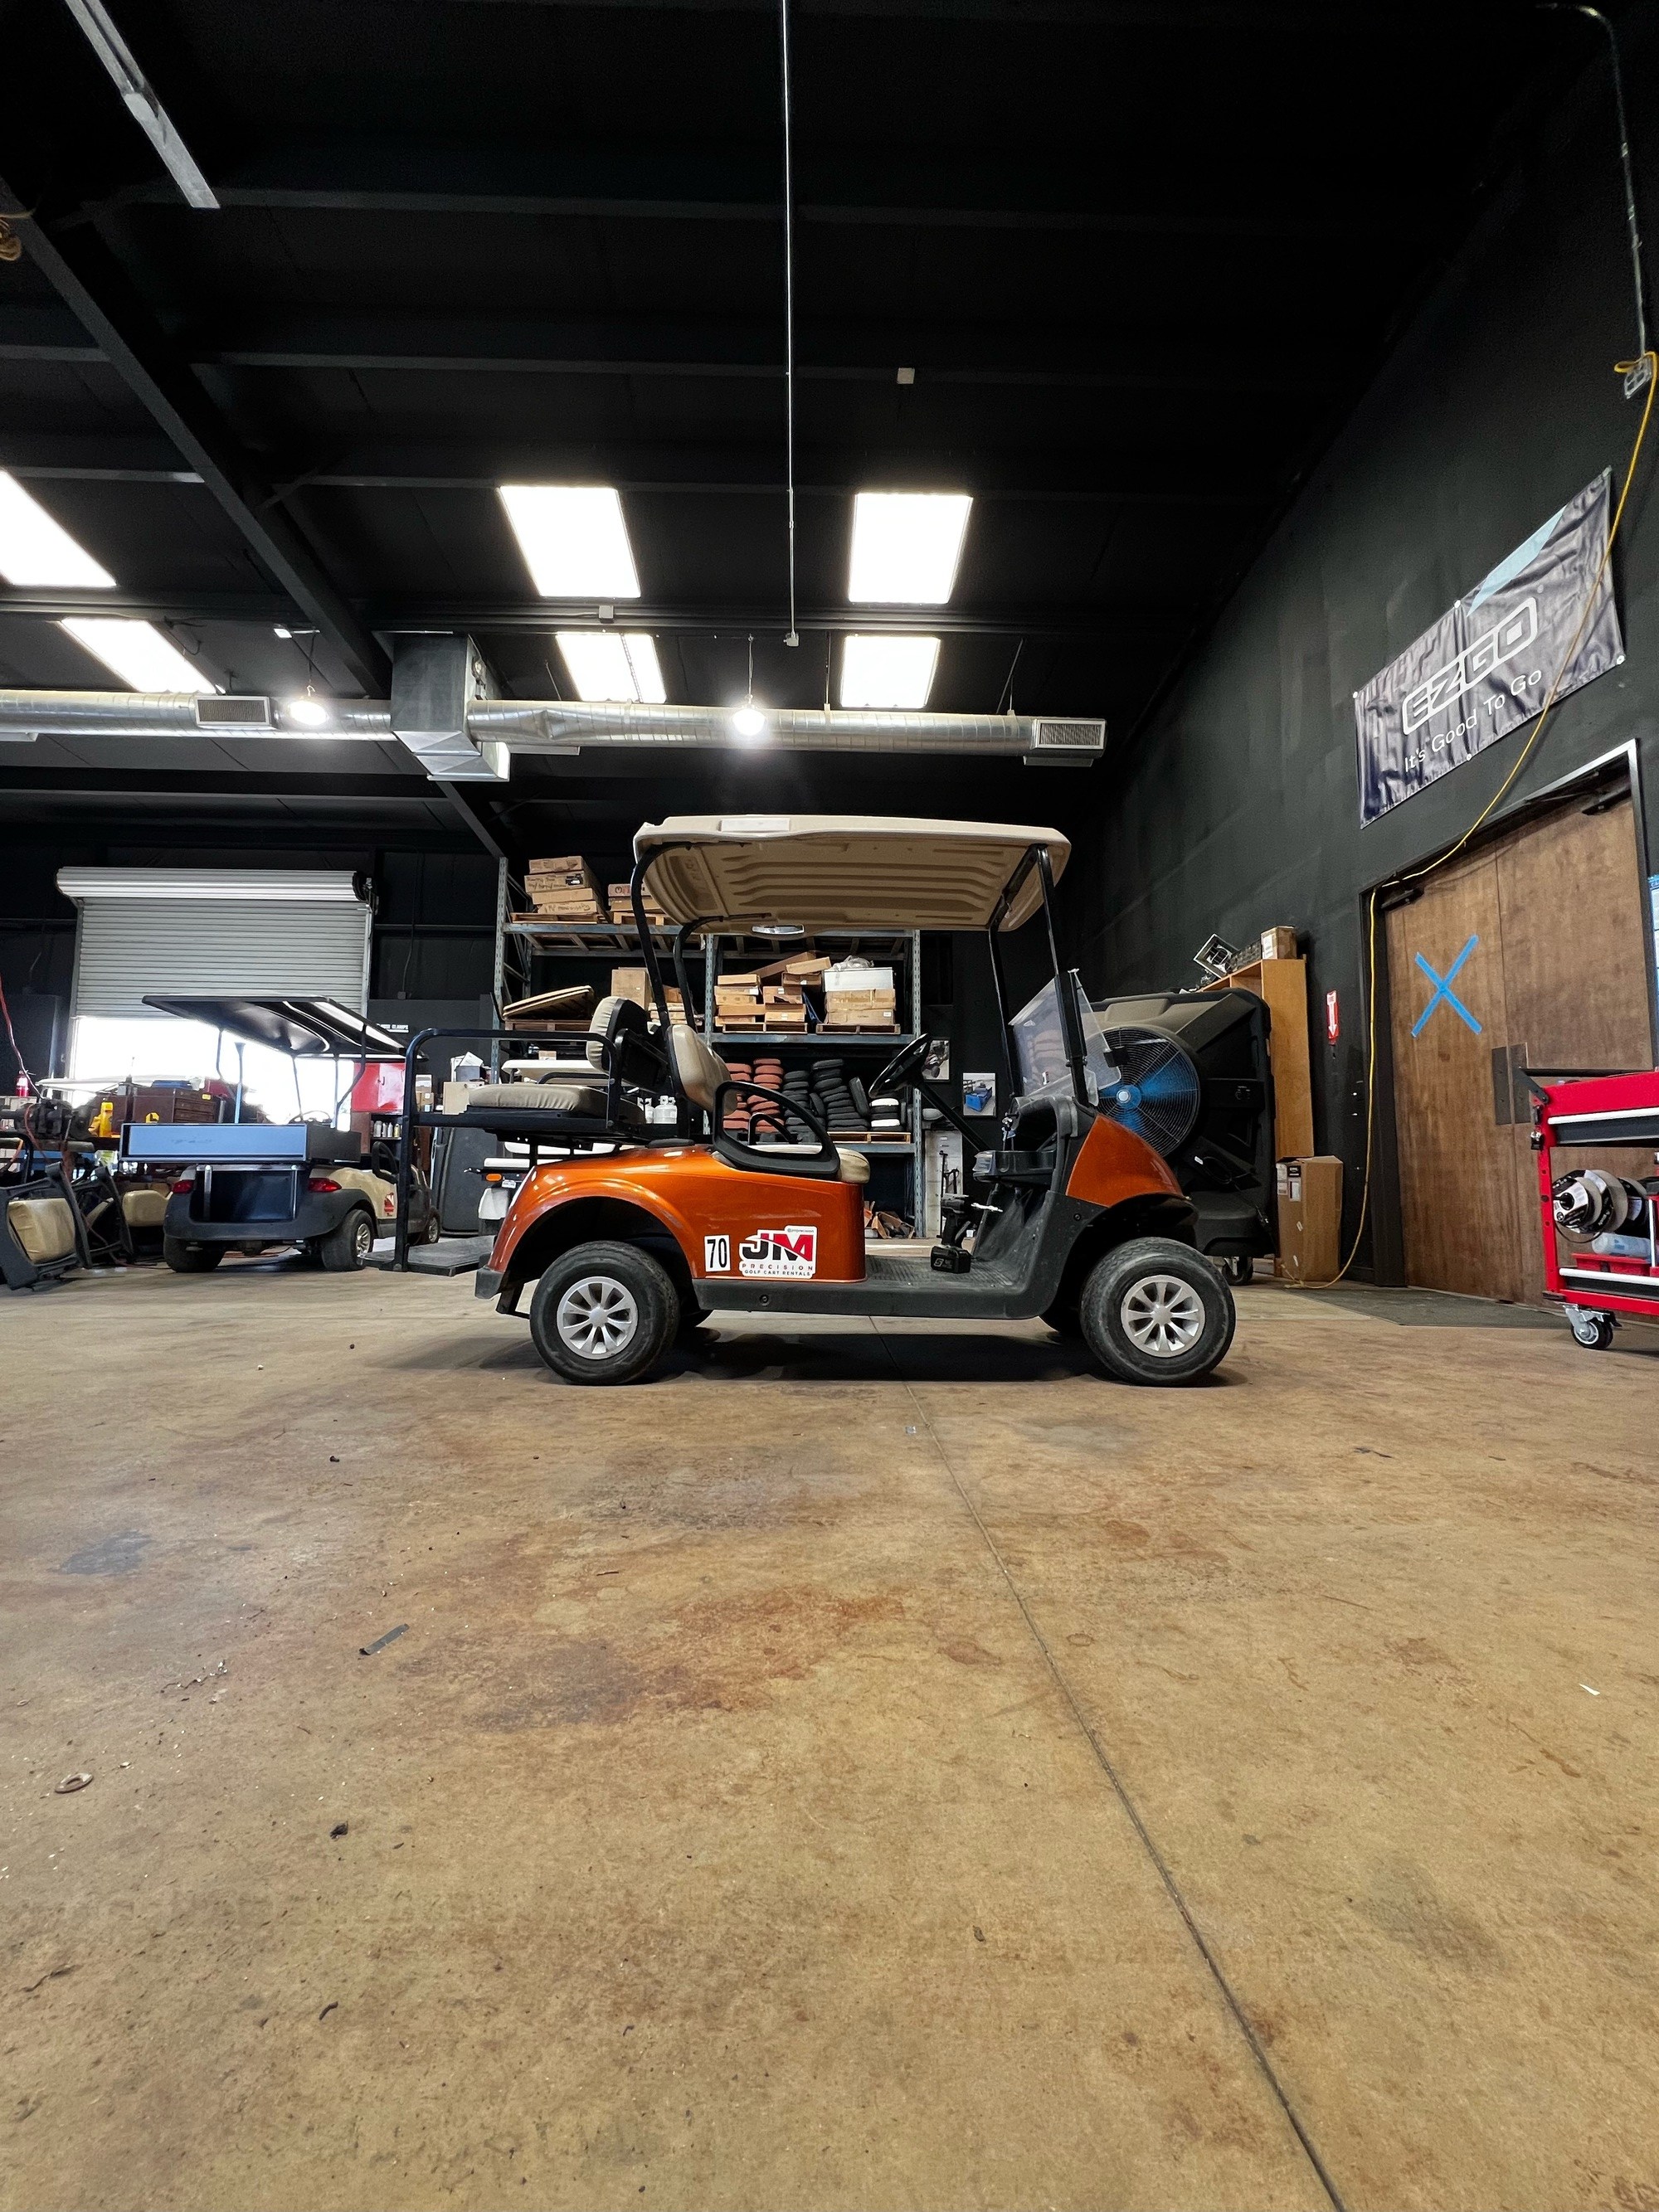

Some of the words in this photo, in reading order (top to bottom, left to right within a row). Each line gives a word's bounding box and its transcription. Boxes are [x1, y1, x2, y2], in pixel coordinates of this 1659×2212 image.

[1402, 596, 1539, 736] EZGO
[1404, 746, 1427, 773] It's
[1431, 709, 1477, 754] Good
[1483, 692, 1506, 717] To
[1511, 668, 1542, 696] Go
[707, 1237, 727, 1268] 70
[742, 1232, 814, 1262] JM
